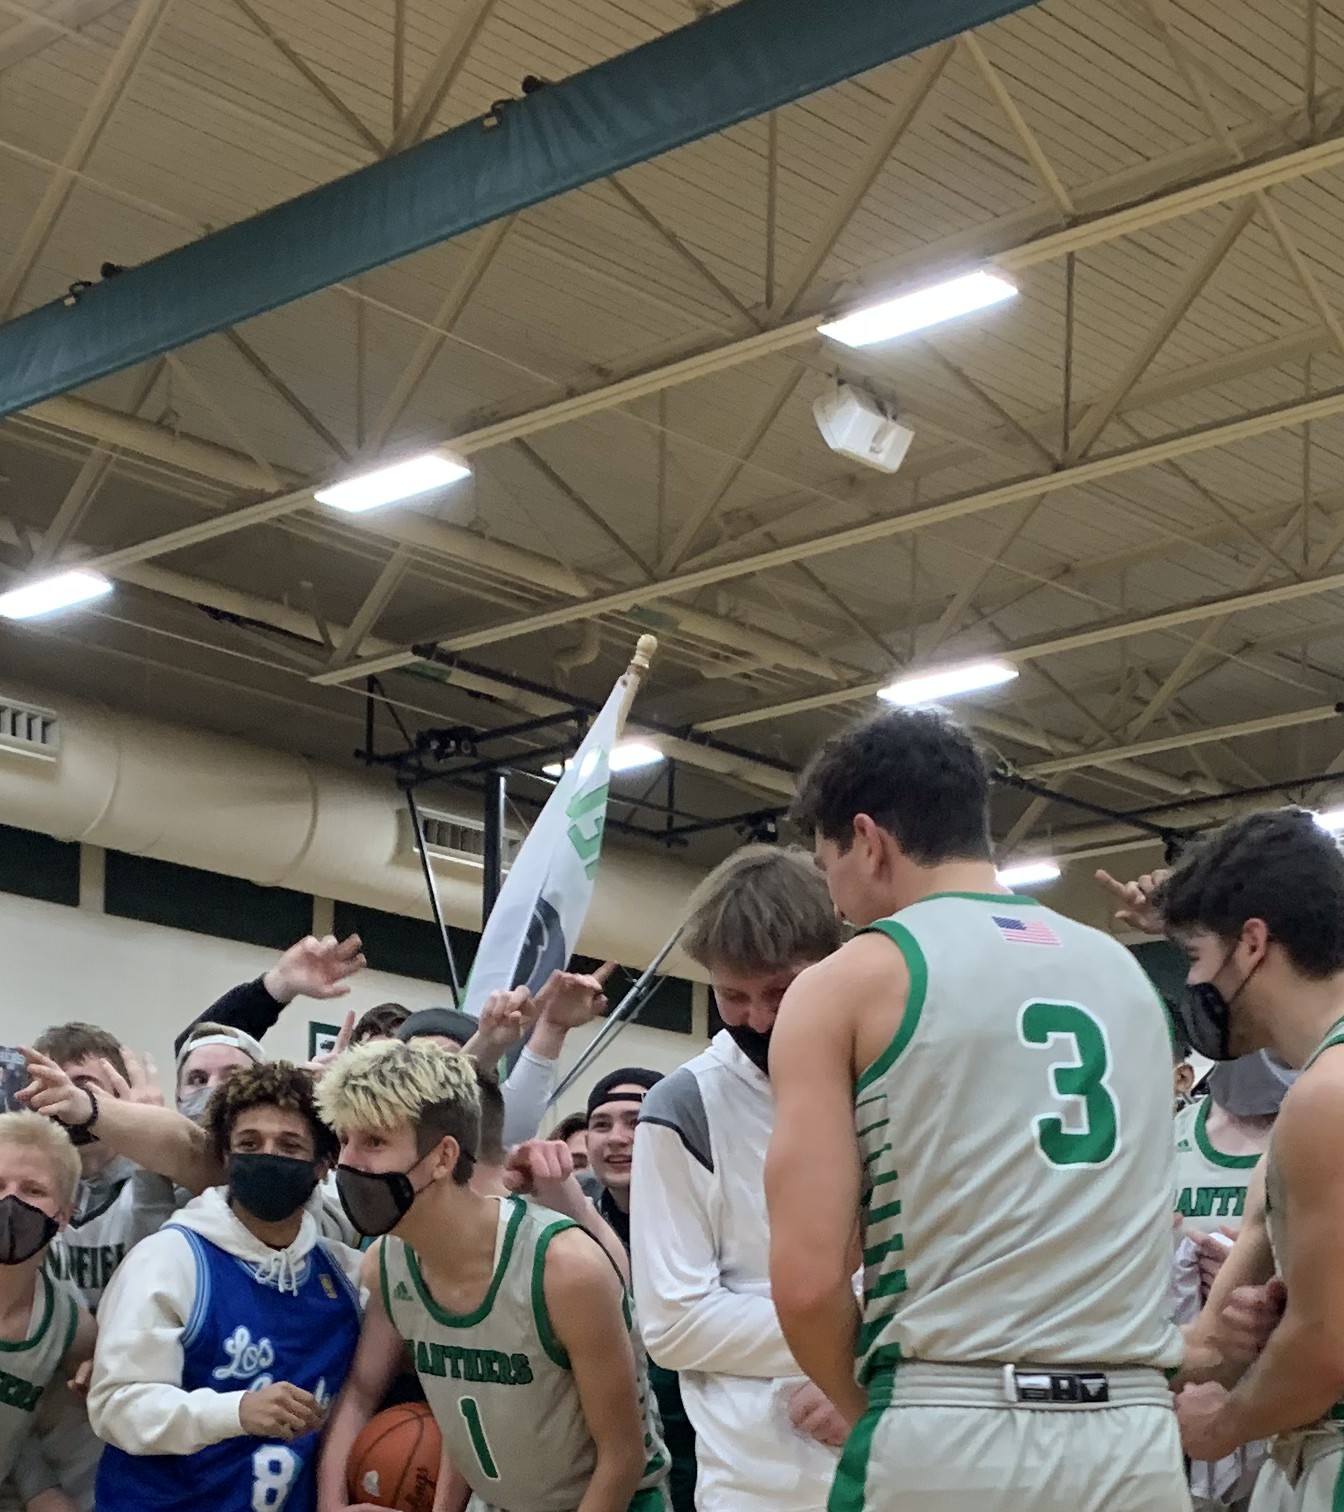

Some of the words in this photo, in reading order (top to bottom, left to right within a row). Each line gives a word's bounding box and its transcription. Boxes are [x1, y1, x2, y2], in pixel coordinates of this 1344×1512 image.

[1017, 997, 1121, 1171] 3
[211, 1323, 276, 1381] Los
[458, 1395, 501, 1481] 1
